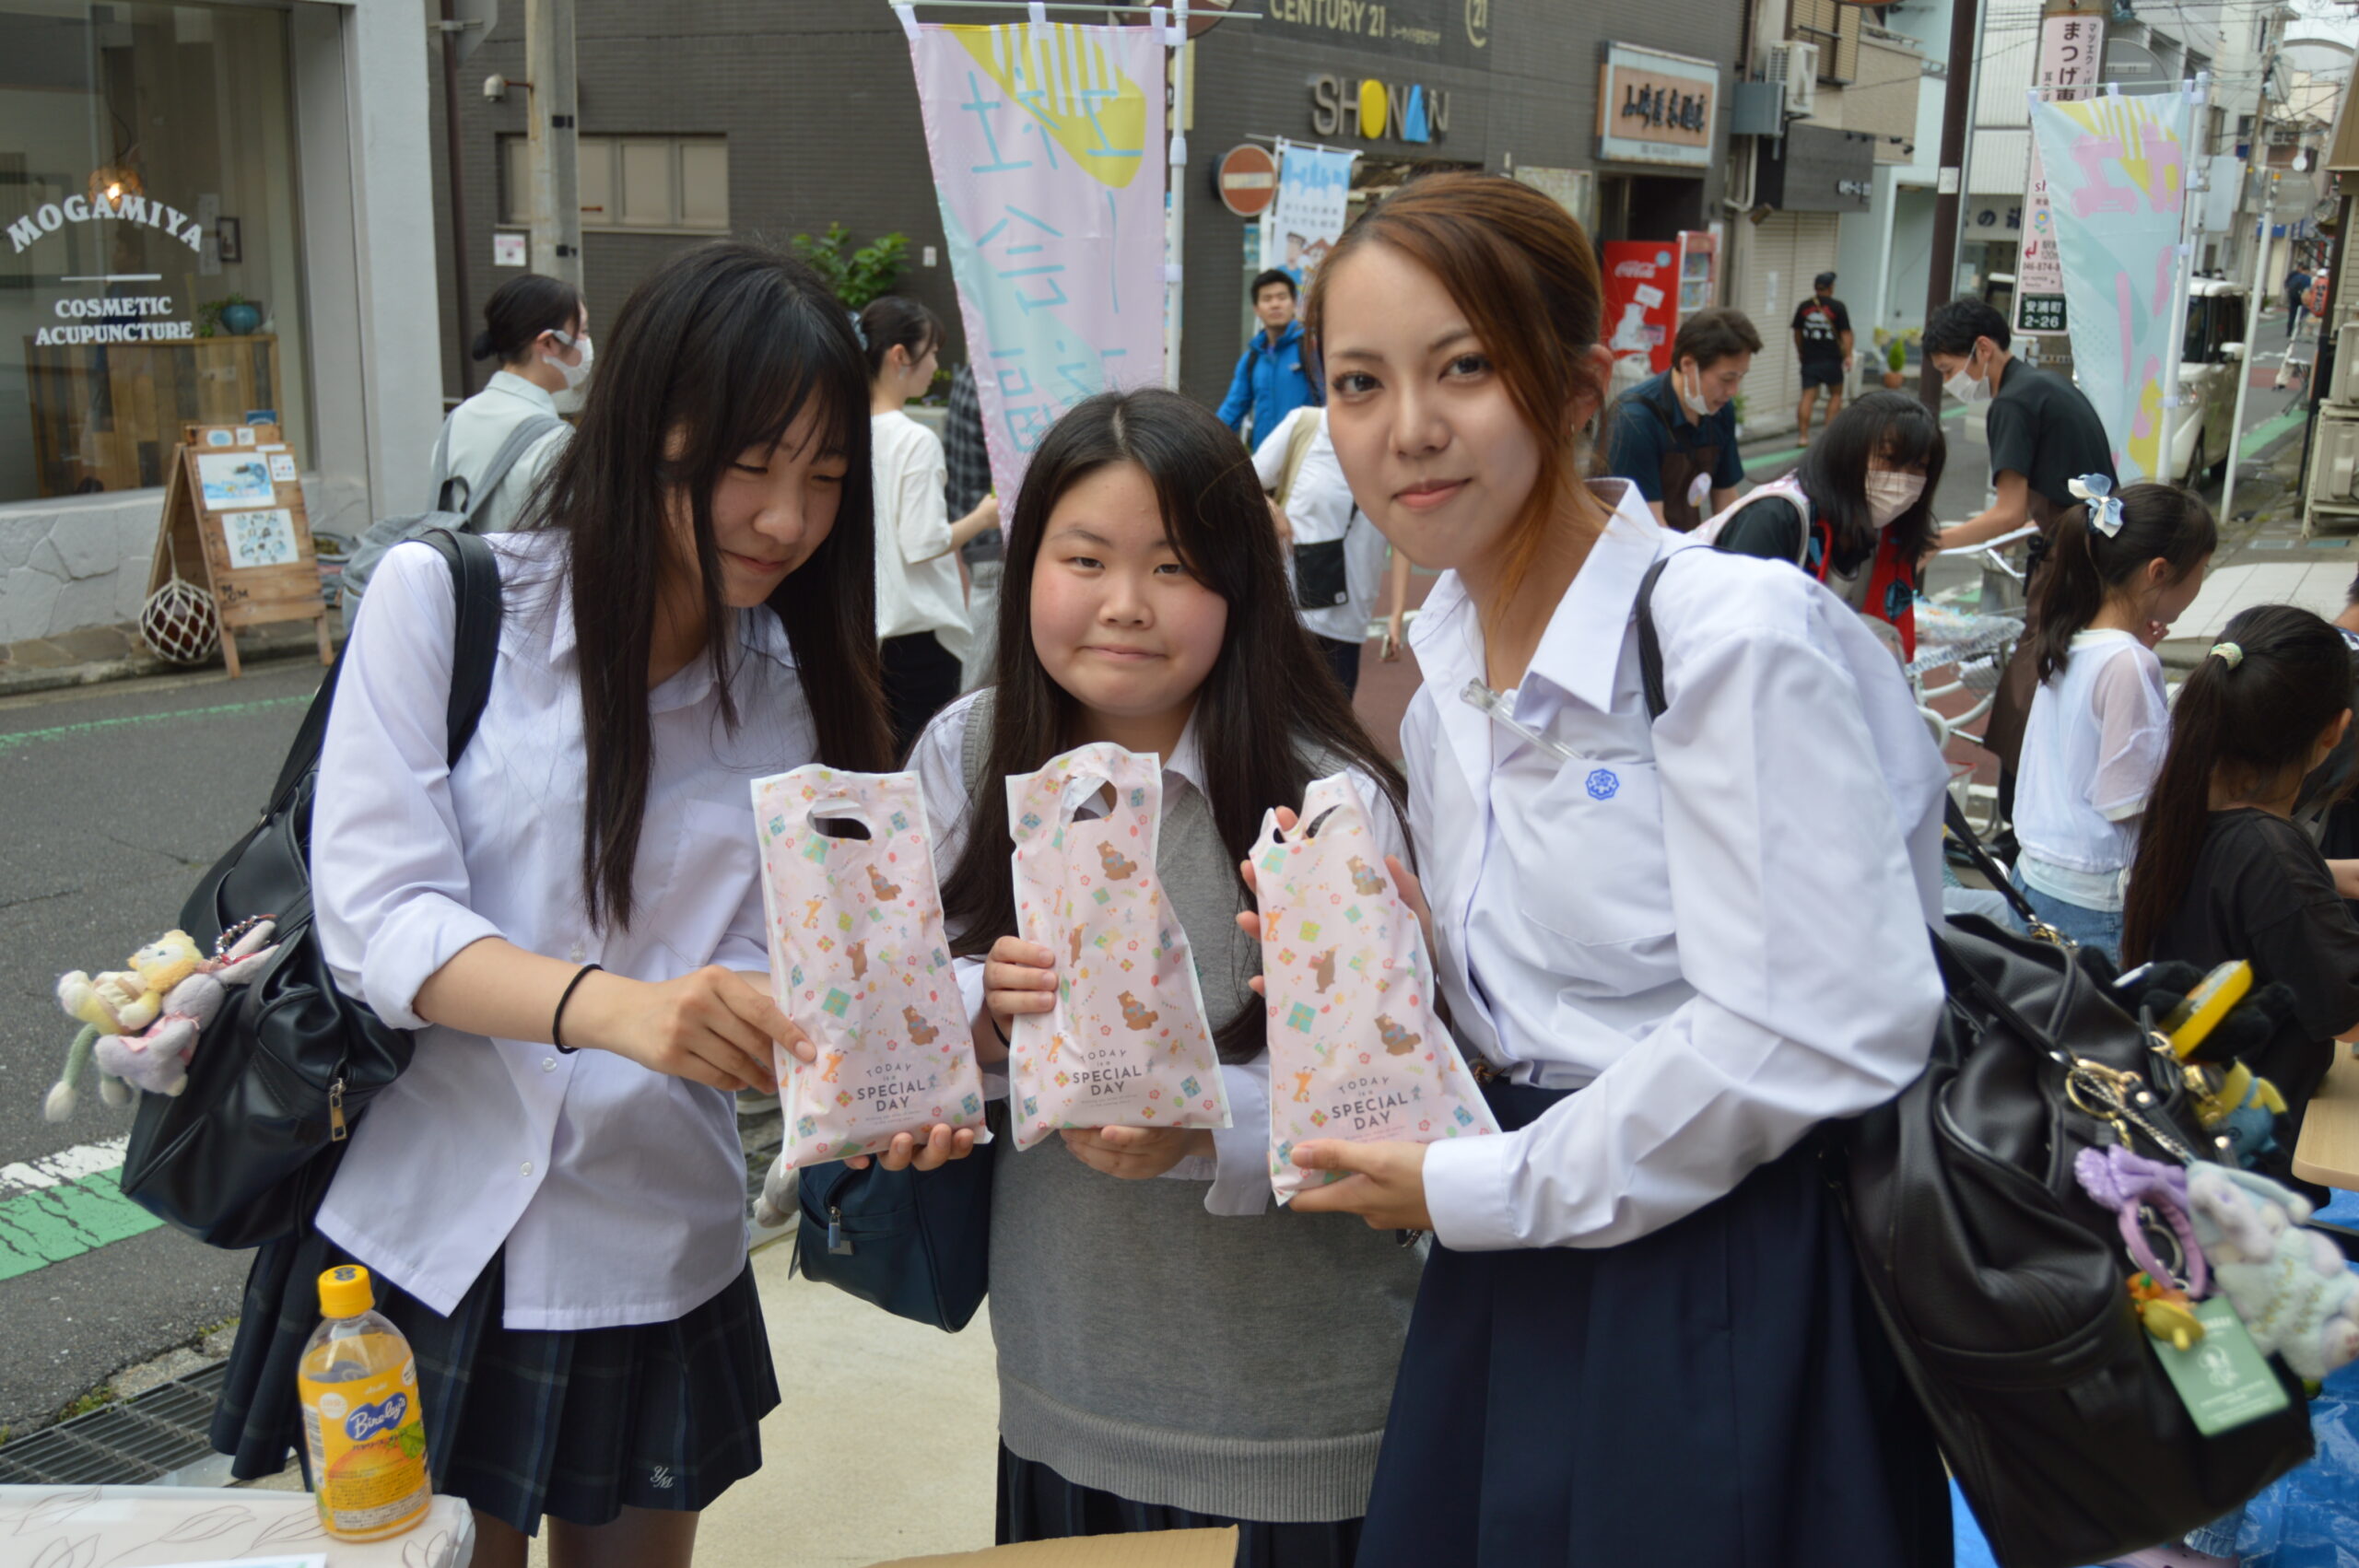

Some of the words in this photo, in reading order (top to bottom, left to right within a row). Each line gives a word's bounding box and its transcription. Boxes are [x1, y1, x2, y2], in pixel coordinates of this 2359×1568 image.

[1270, 0, 1365, 33] CENTURY
[1368, 5, 1386, 38] 21
[1313, 73, 1450, 144] SHONAN
[6, 193, 204, 254] MOGAMIYA
[54, 296, 173, 319] COSMETIC
[2025, 299, 2063, 314] 安浦町
[2024, 315, 2060, 329] 2-26
[34, 321, 195, 346] ACUPUNCTURE
[1080, 1047, 1127, 1063] TODAY
[866, 1062, 912, 1078] TODAY
[1073, 1065, 1142, 1084] SPECIAL
[857, 1079, 926, 1101] SPECIAL
[1090, 1081, 1125, 1096] DAY
[1338, 1077, 1390, 1094] TODAY
[875, 1096, 910, 1113] DAY
[1332, 1093, 1408, 1118] SPECIAL
[1354, 1110, 1391, 1131] DAY
